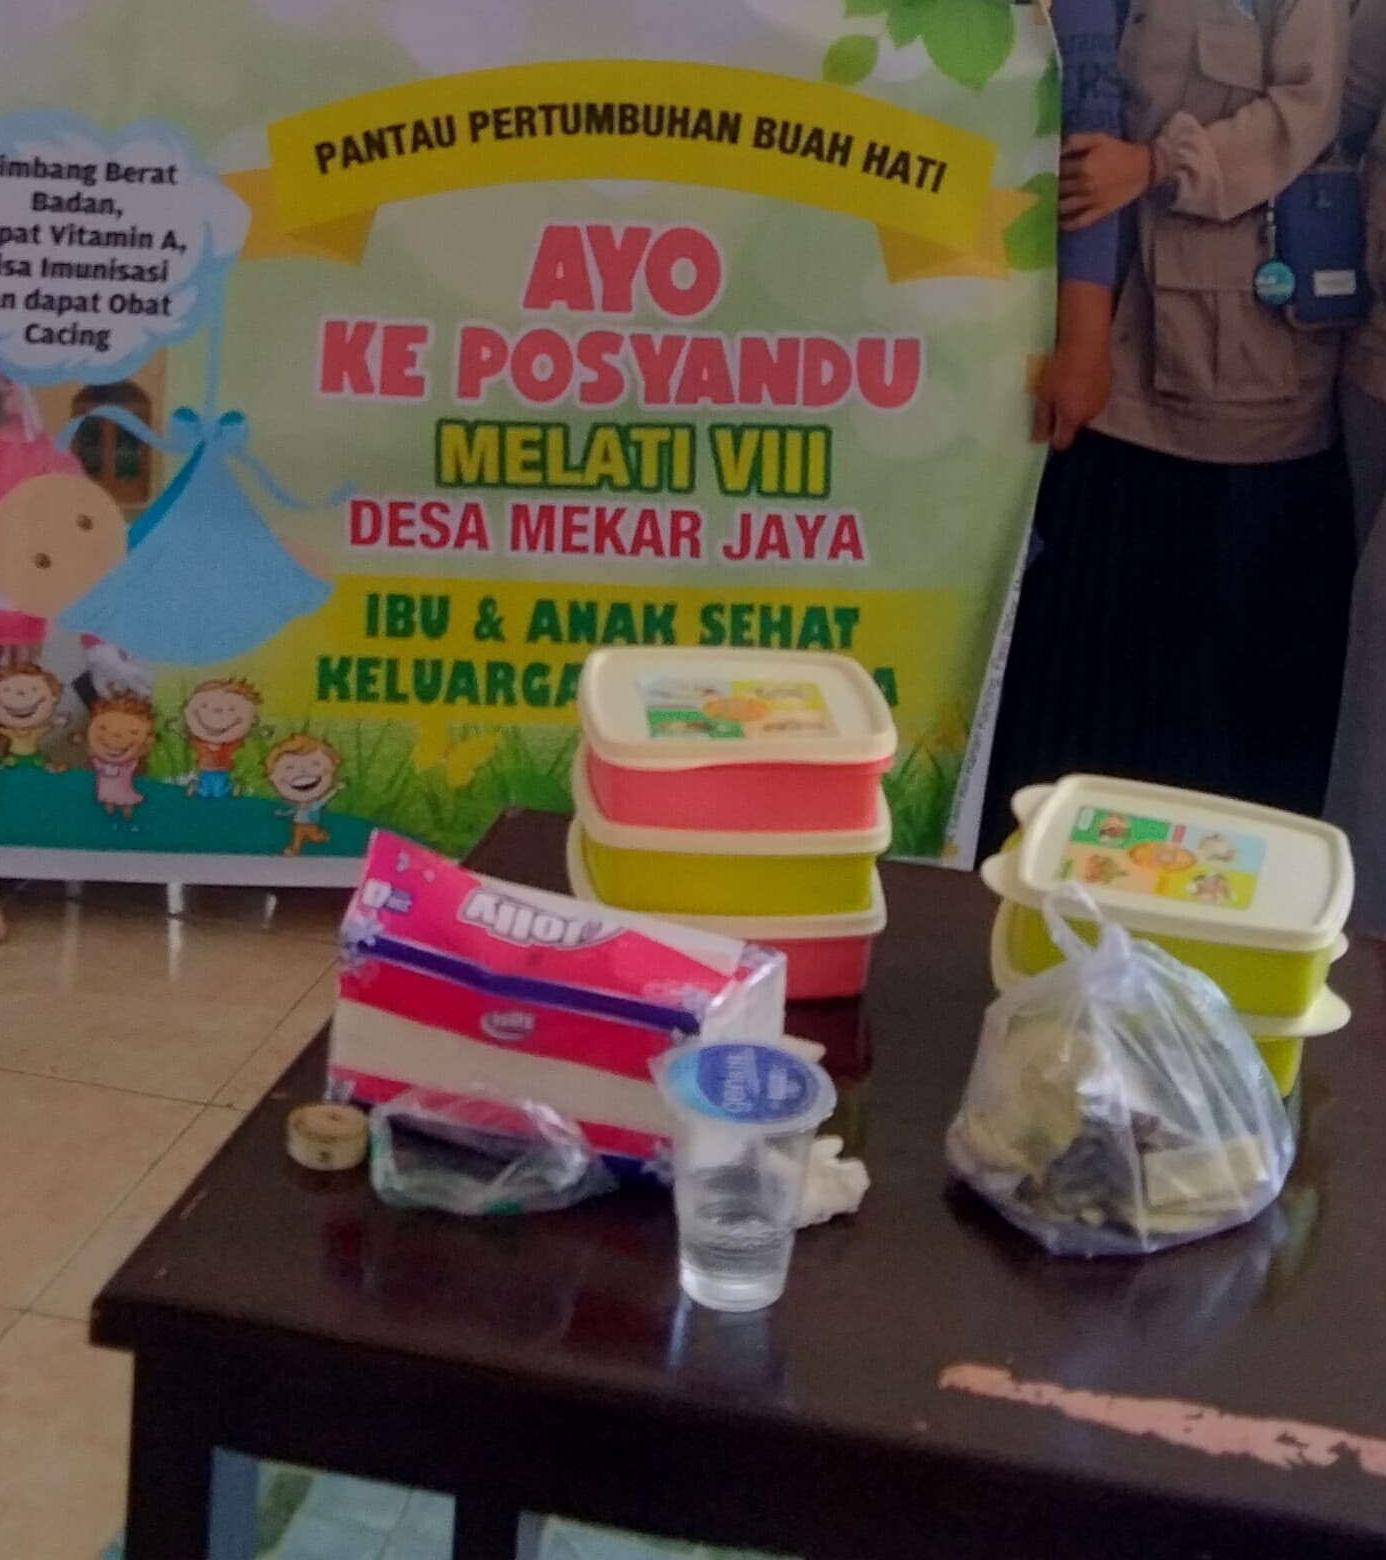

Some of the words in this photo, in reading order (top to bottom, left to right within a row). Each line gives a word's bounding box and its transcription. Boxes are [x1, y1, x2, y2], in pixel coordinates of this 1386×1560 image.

[314, 114, 457, 175] PANTAU
[468, 102, 743, 145] PERTUMBUHAN
[752, 115, 855, 167] BUAH
[861, 141, 948, 194] HATI
[104, 161, 178, 186] Berat
[31, 191, 124, 219] Badan,
[50, 223, 154, 249] Vitamin
[160, 230, 188, 254] A,
[40, 257, 170, 283] Imunisasi
[522, 224, 722, 318] AYO
[24, 288, 102, 317] dapat
[108, 292, 172, 317] Obat
[24, 322, 111, 353] Cacing
[319, 320, 429, 399] KE
[457, 325, 921, 409] POSYANDU
[436, 419, 696, 493] MELATI
[710, 424, 832, 498] VIII
[349, 500, 489, 551] DESA
[510, 503, 702, 560] MEKAR
[722, 512, 866, 561] JAYA
[365, 592, 451, 639] IBU
[473, 596, 506, 642] &
[526, 599, 679, 648] ANAK
[698, 602, 862, 651] SEHAT
